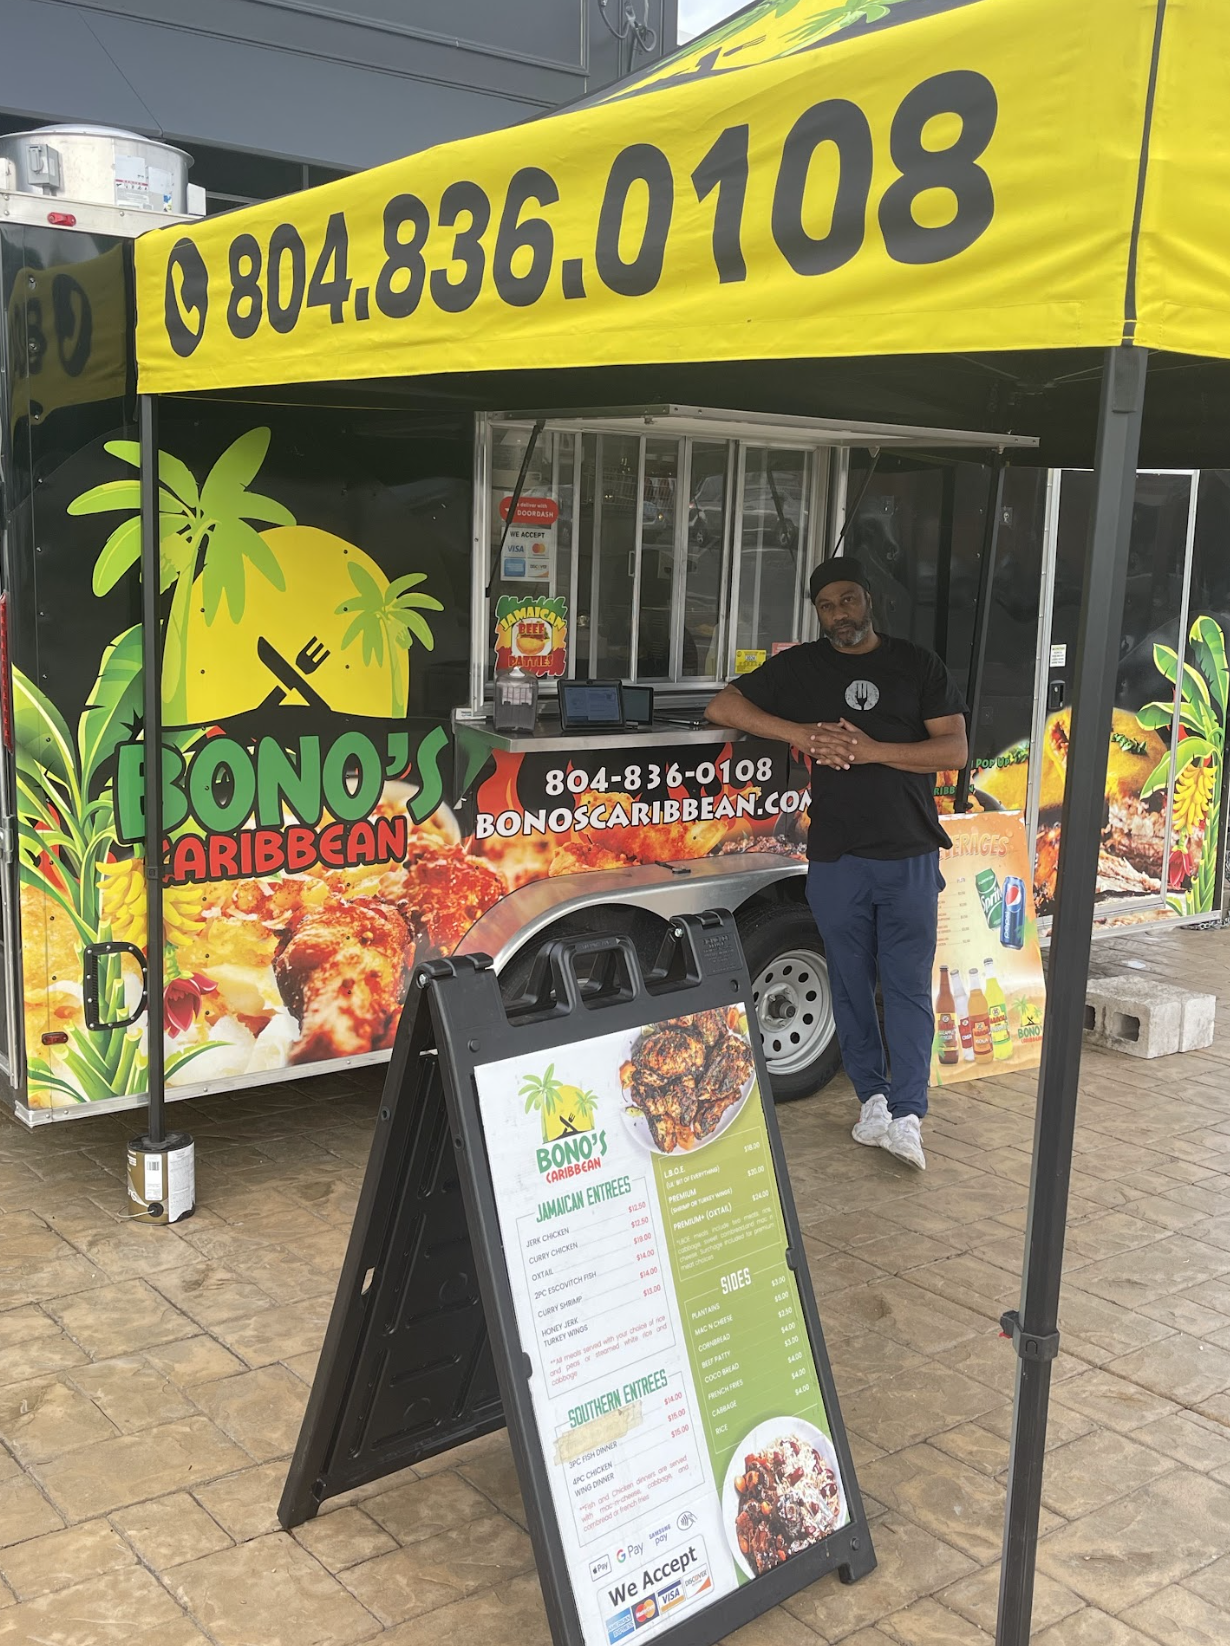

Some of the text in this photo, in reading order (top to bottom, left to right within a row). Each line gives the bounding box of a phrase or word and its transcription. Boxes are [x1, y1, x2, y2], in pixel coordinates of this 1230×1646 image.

[227, 70, 998, 339] 804.836.0108
[517, 510, 554, 518] DOORDASH
[507, 544, 524, 552] VISA
[500, 606, 566, 631] JAMAICAN
[518, 622, 544, 634] BEEF
[508, 655, 553, 668] PATTIES
[976, 758, 996, 768] POP
[996, 758, 1010, 767] UP
[117, 725, 449, 840] BONO'S
[545, 757, 773, 796] 804-836-0108
[164, 819, 407, 882] ARIBBEAN
[535, 1129, 609, 1174] BONO'S
[545, 1157, 601, 1184] CARIBBEAN
[747, 1164, 764, 1176] $20.00
[534, 1175, 631, 1223] JAMAICAN ENTREES
[668, 1188, 696, 1203] PREMIUM
[690, 1199, 697, 1207] OR
[698, 1193, 715, 1204] TURKEY
[752, 1189, 769, 1201] $24.00
[628, 1201, 646, 1213] $12.50
[673, 1202, 732, 1230] PREMIUM+ (OXTAIL)
[630, 1216, 649, 1228] $12.50
[525, 1227, 569, 1248] JERK CHICKEN
[528, 1241, 578, 1265] CURRY CHICKEN
[636, 1248, 655, 1261] $14.00
[531, 1268, 553, 1281] OXTAIL
[639, 1266, 658, 1279] $14.00
[719, 1267, 751, 1295] SIDES
[771, 1275, 786, 1287] $3.00
[534, 1270, 596, 1299] 2PC ESCOVITCH FISH
[774, 1290, 789, 1302] $5.00
[537, 1295, 582, 1318] CURRY SHRIMP
[691, 1302, 720, 1320] PLANTAINS
[777, 1306, 792, 1318] $2.50
[541, 1317, 578, 1337] HONEY JERK
[543, 1323, 588, 1347] TURKEY WINGS
[694, 1314, 733, 1336] MAC N CHEESE
[780, 1321, 795, 1334] $4.00
[563, 1348, 581, 1361] meals
[582, 1340, 602, 1354] served
[602, 1335, 614, 1345] with
[616, 1330, 628, 1341] your
[629, 1321, 647, 1334] choice
[648, 1318, 654, 1326] of
[655, 1314, 665, 1323] rice
[698, 1332, 730, 1352] CORNBREAD
[784, 1334, 799, 1347] $3.00
[549, 1366, 561, 1377] and
[565, 1360, 580, 1371] peas
[595, 1342, 619, 1358] steamed
[623, 1334, 638, 1346] white
[641, 1329, 652, 1338] rice
[656, 1322, 667, 1333] and
[701, 1349, 731, 1369] BEEF PATTY
[787, 1351, 802, 1364] $4.00
[551, 1369, 578, 1387] cabbage
[704, 1362, 739, 1384] COCO BREAD
[791, 1367, 806, 1380] $4.00
[567, 1368, 668, 1428] SOUTHERN ENTREES
[707, 1378, 743, 1401] FRENCH FRIES
[794, 1383, 809, 1396] $4.00
[711, 1399, 737, 1418] CABBAGE
[715, 1423, 728, 1435] RICE
[568, 1440, 617, 1469] 3PC FISH DINNER
[572, 1460, 612, 1486] 4PC CHICKEN
[597, 1492, 609, 1504] and
[611, 1480, 633, 1498] Chicken
[635, 1469, 656, 1485] dinners
[657, 1464, 667, 1474] are
[669, 1454, 687, 1469] served
[574, 1471, 614, 1497] WING DINNER
[581, 1511, 593, 1523] with
[677, 1462, 689, 1474] and
[583, 1511, 612, 1533] cornbread
[619, 1498, 637, 1513] french
[648, 1523, 671, 1540] SAMSUNG
[654, 1532, 668, 1546] pay
[627, 1538, 645, 1560] Pay
[597, 1560, 608, 1572] Pay
[608, 1544, 697, 1608] We Accept
[685, 1569, 707, 1587] DISCOVER
[662, 1587, 680, 1605] VISA
